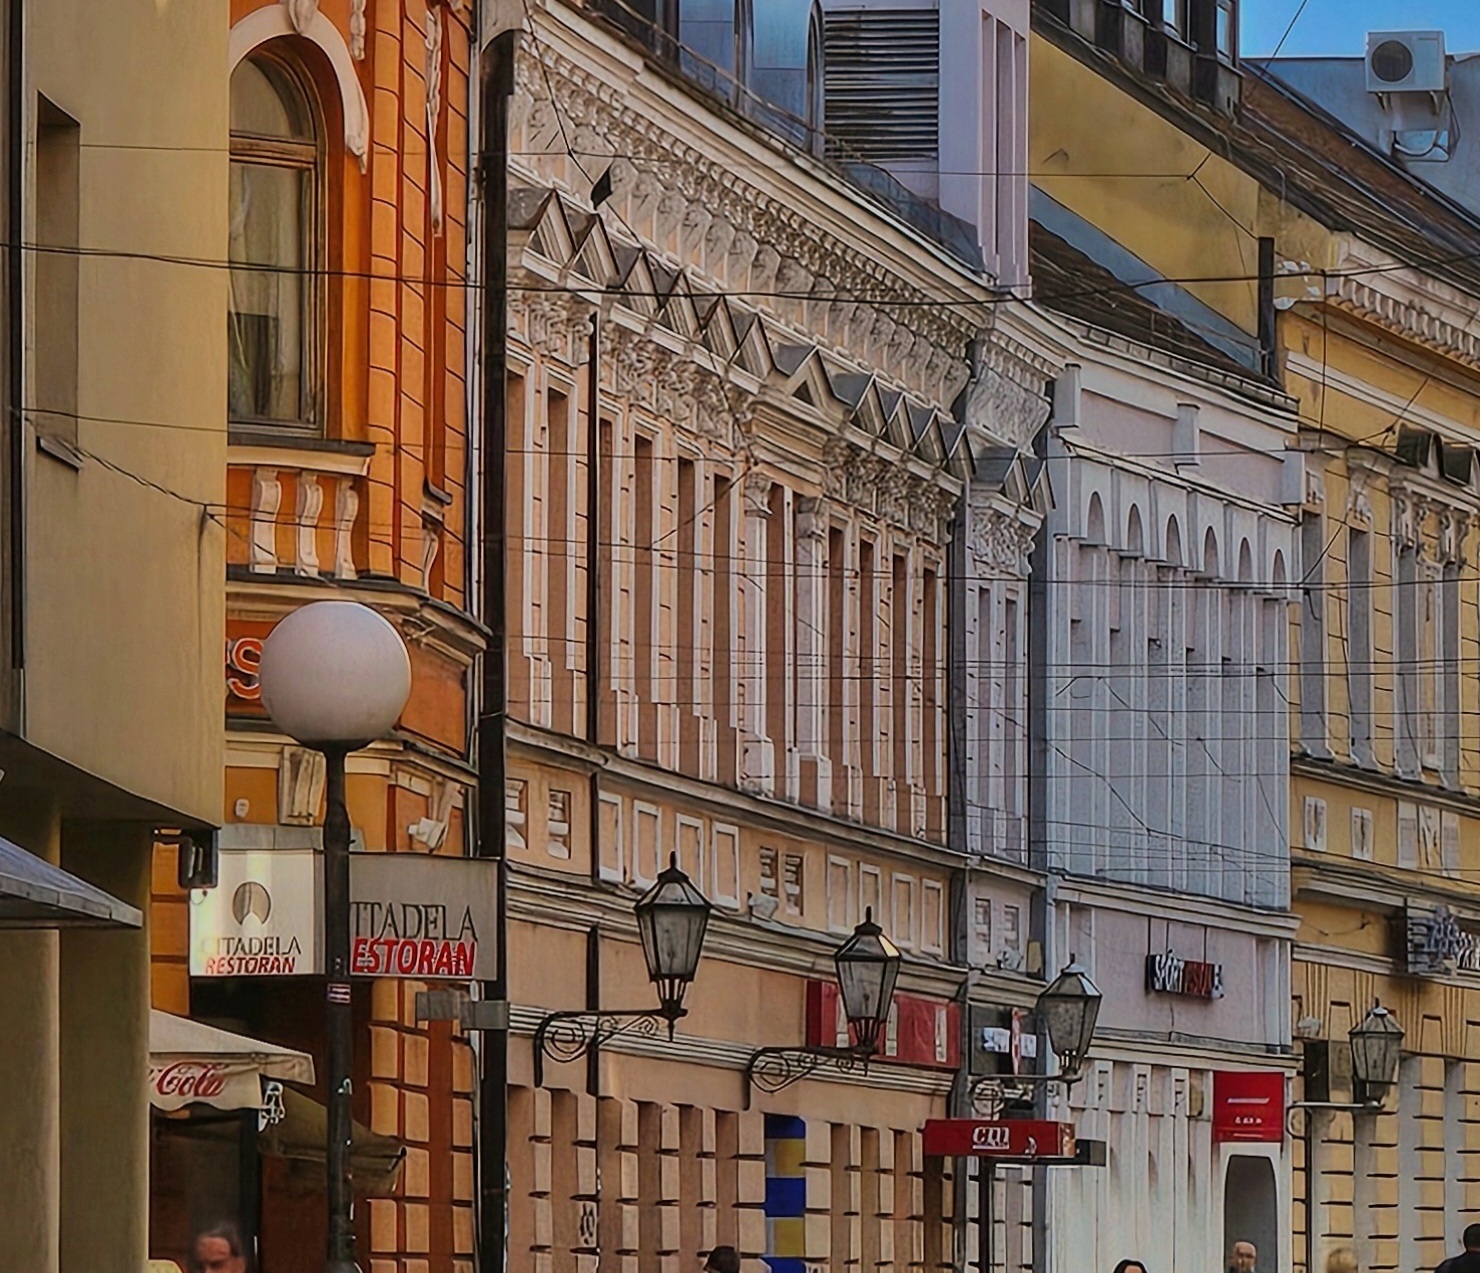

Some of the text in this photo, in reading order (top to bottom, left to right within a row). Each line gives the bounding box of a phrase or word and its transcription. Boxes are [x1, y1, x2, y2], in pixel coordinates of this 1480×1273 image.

[350, 901, 479, 942] ITADELA
[205, 956, 297, 974] RESTORAN
[352, 937, 477, 977] ESTORAN
